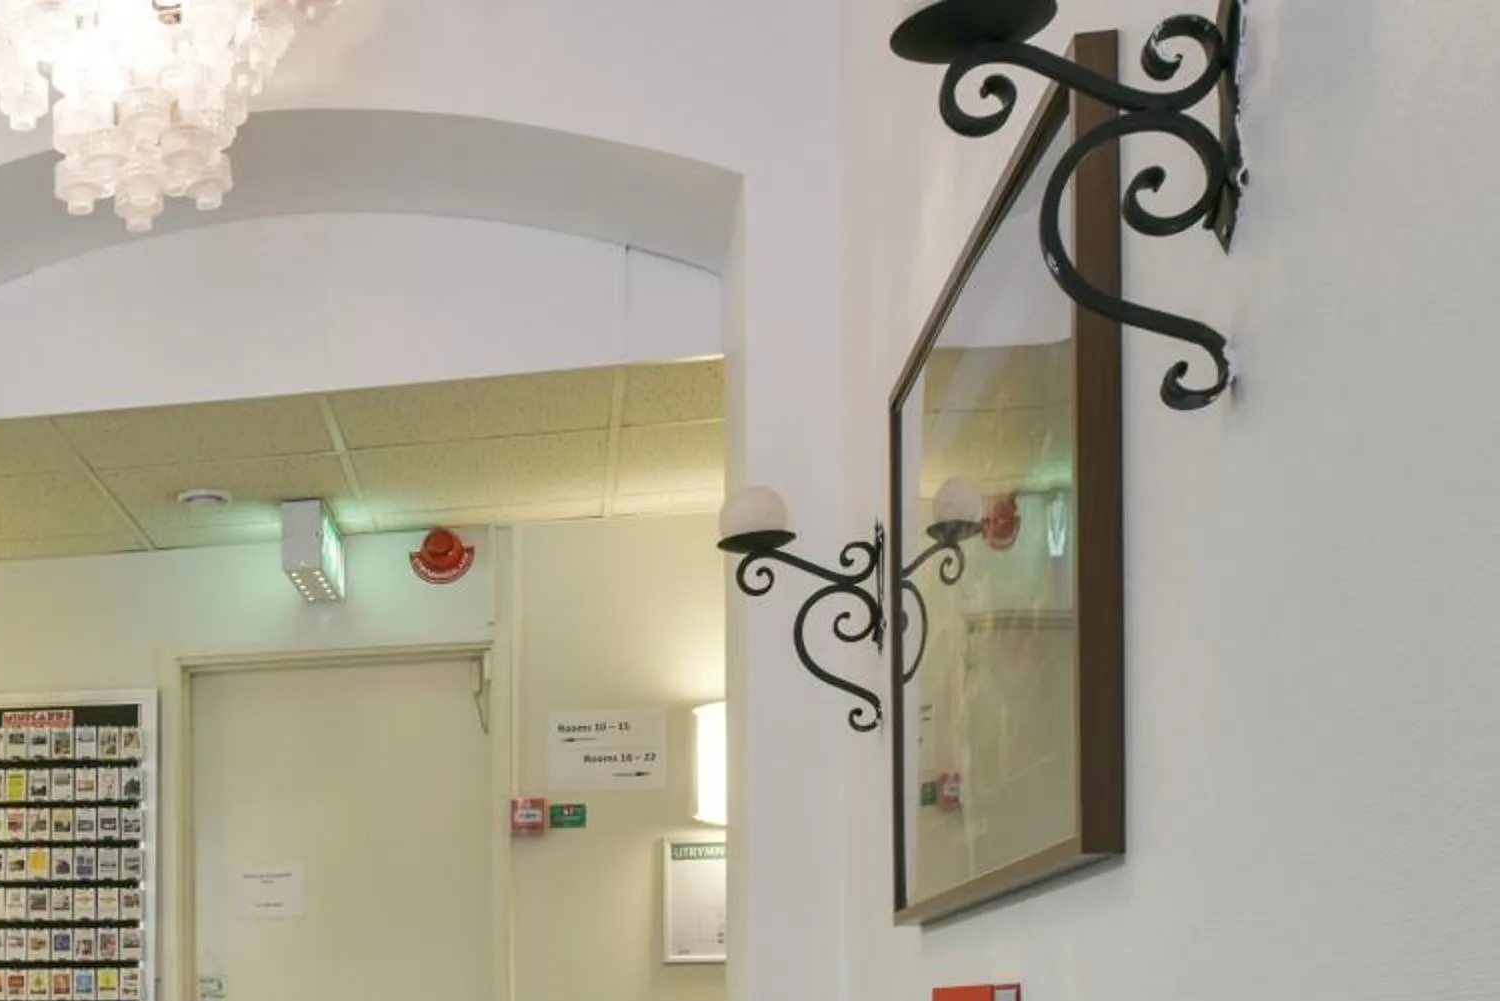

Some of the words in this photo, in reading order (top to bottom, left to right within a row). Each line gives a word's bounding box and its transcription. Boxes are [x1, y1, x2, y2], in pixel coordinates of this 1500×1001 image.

[557, 723, 592, 733] Rooms
[594, 722, 607, 732] 10
[583, 753, 617, 764] Rooms
